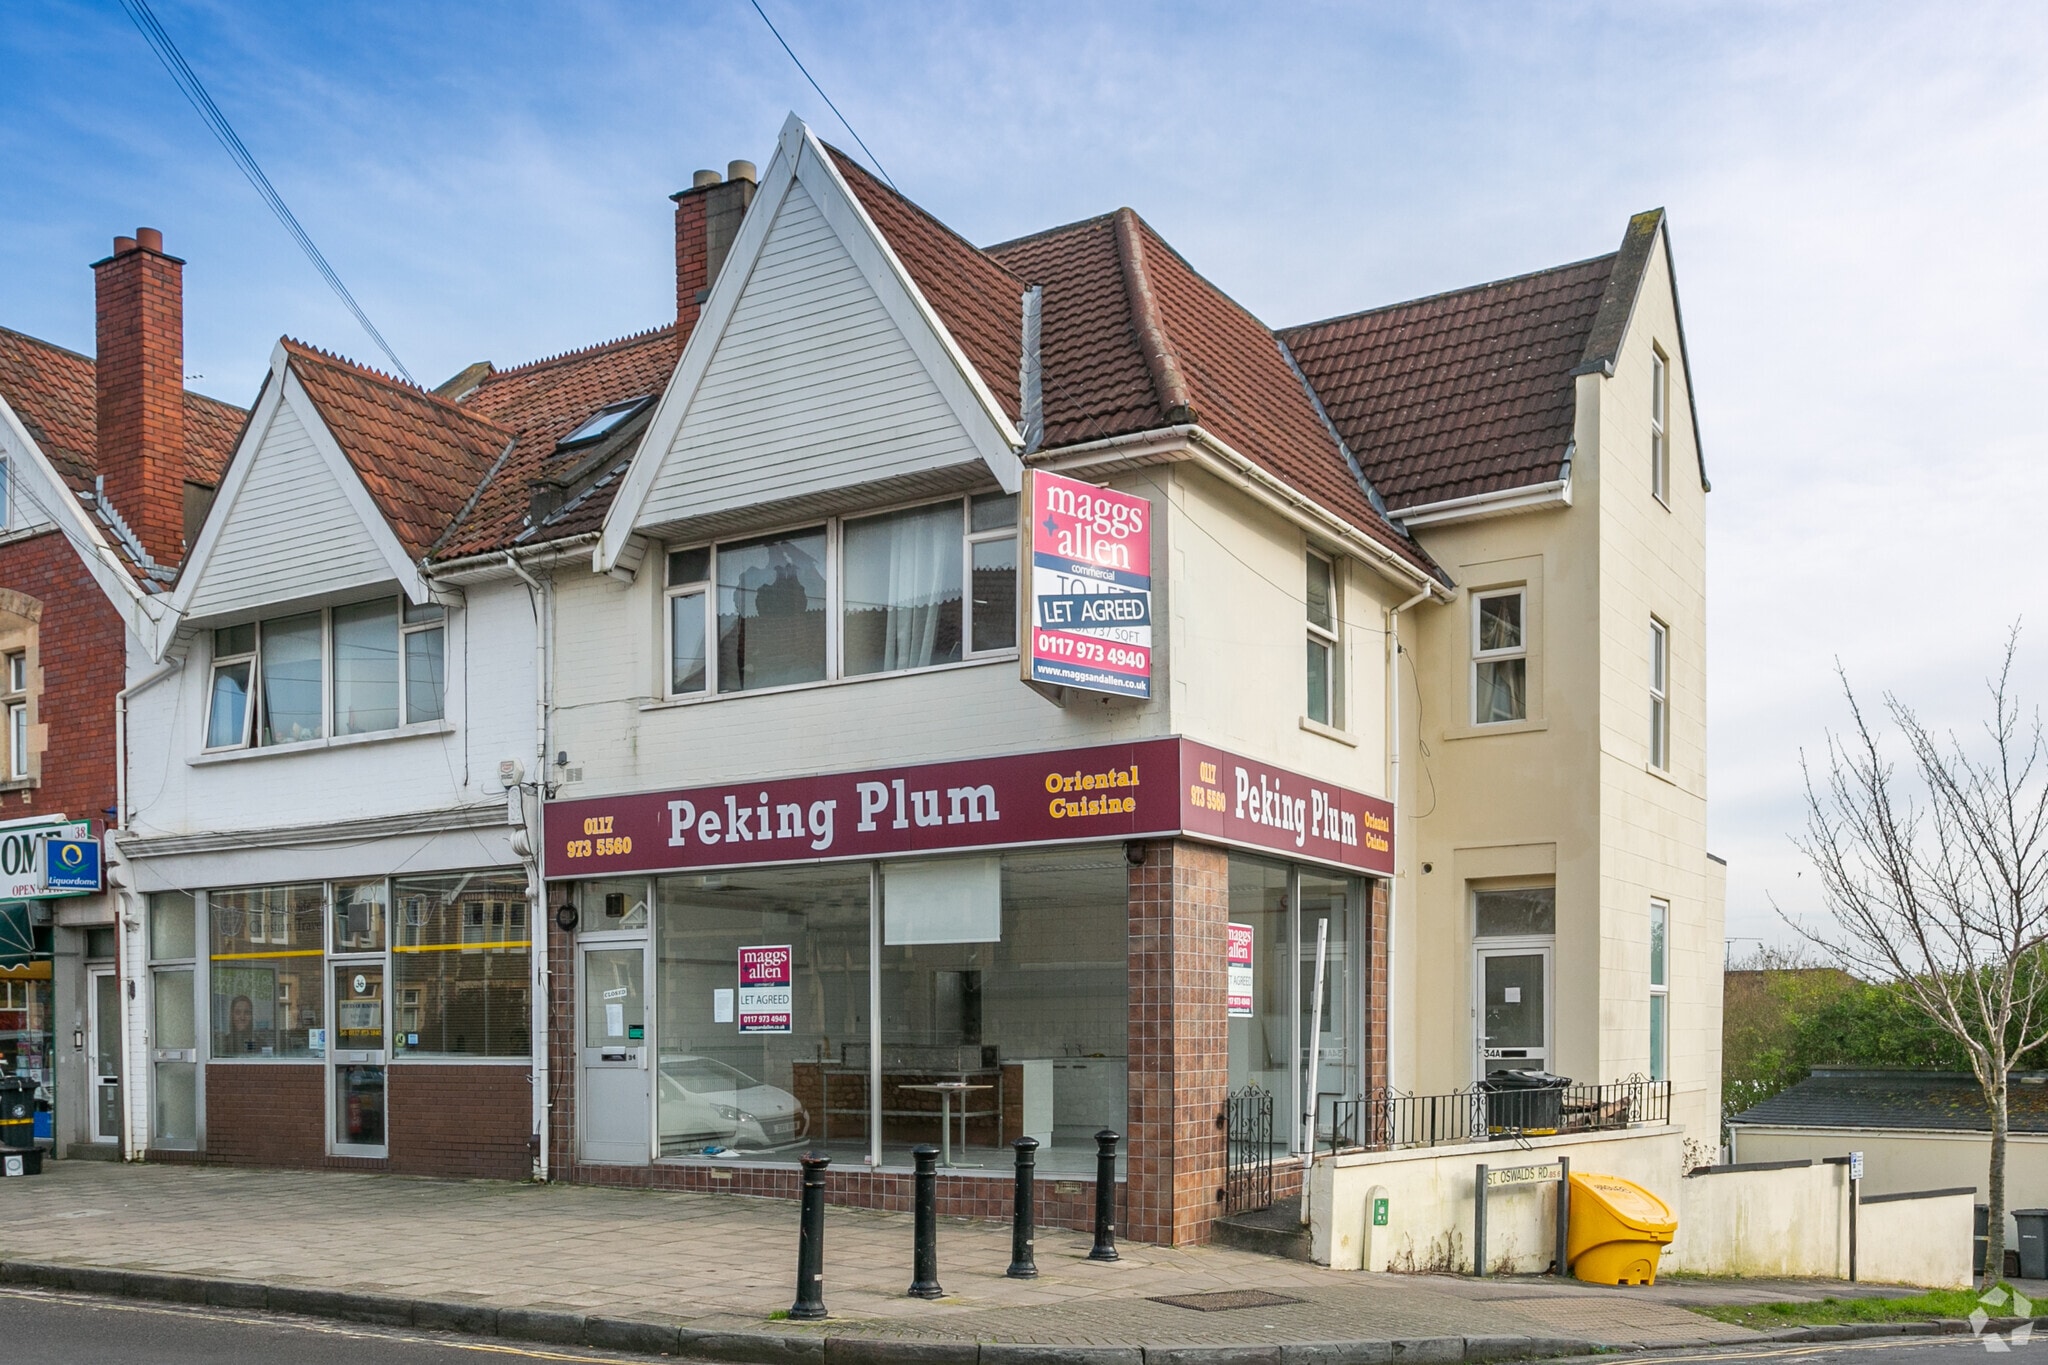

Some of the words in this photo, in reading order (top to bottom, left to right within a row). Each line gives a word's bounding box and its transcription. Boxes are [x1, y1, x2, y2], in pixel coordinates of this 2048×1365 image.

[1046, 486, 1143, 539] maggs
[1057, 522, 1131, 570] allen
[1071, 564, 1115, 580] commercial
[1043, 600, 1074, 623] LET
[1081, 599, 1145, 622] AGREED
[1038, 634, 1074, 656] 0117
[1076, 641, 1104, 661] 973
[1107, 648, 1145, 669] 4940
[1037, 664, 1147, 690] www.maggsandallen.co.uk
[1045, 765, 1140, 793] Oriental
[1199, 761, 1217, 785] 0117
[1049, 794, 1136, 819] Cuisine
[1190, 785, 1205, 808] 973
[1206, 789, 1227, 812] 5560
[1235, 766, 1306, 847] Peking
[1310, 788, 1358, 846] Plum
[667, 791, 837, 851] Peking
[856, 779, 1000, 832] Plum
[1364, 811, 1389, 833] Oriental
[75, 826, 86, 839] 38
[583, 816, 614, 836] 0117
[566, 840, 592, 858] 973
[596, 837, 632, 855] 5560
[1365, 832, 1389, 853] Cuisine
[1, 830, 62, 876] OM
[12, 884, 36, 897] OPEN
[49, 876, 97, 887] Liquordome
[249, 919, 292, 934] Christian
[744, 950, 787, 966] maggs
[1228, 942, 1248, 959] allen
[749, 964, 782, 979] allen
[355, 980, 365, 988] 36
[604, 988, 627, 998] CLOSED
[740, 995, 754, 1005] LET
[756, 994, 789, 1005] AGREED
[743, 1015, 757, 1023] 0117
[1484, 1049, 1500, 1058] 34A
[1500, 1168, 1535, 1183] OSWALDS
